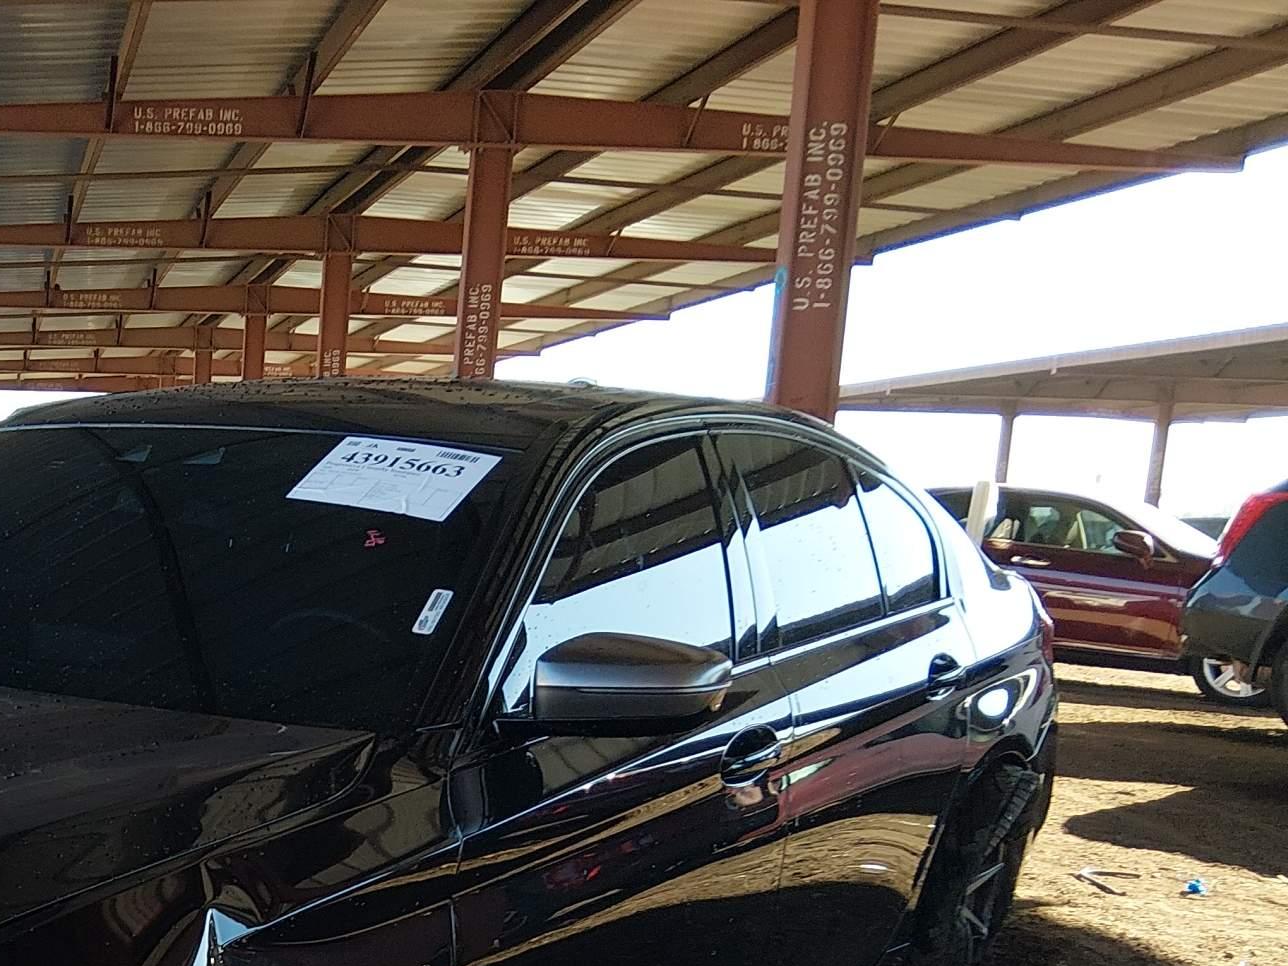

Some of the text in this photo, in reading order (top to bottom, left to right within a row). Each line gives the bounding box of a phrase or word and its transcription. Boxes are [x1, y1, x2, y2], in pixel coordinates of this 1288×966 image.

[134, 106, 243, 121] U.S. PREFAB INC.
[135, 121, 242, 135] 1-866-799-0969
[742, 122, 768, 138] U.S.
[792, 121, 828, 311] U.S. PREFAB INC.
[813, 122, 848, 309] 1-866-799-0969
[464, 284, 480, 365] PREFAB INC.
[341, 450, 466, 478] 43915663
